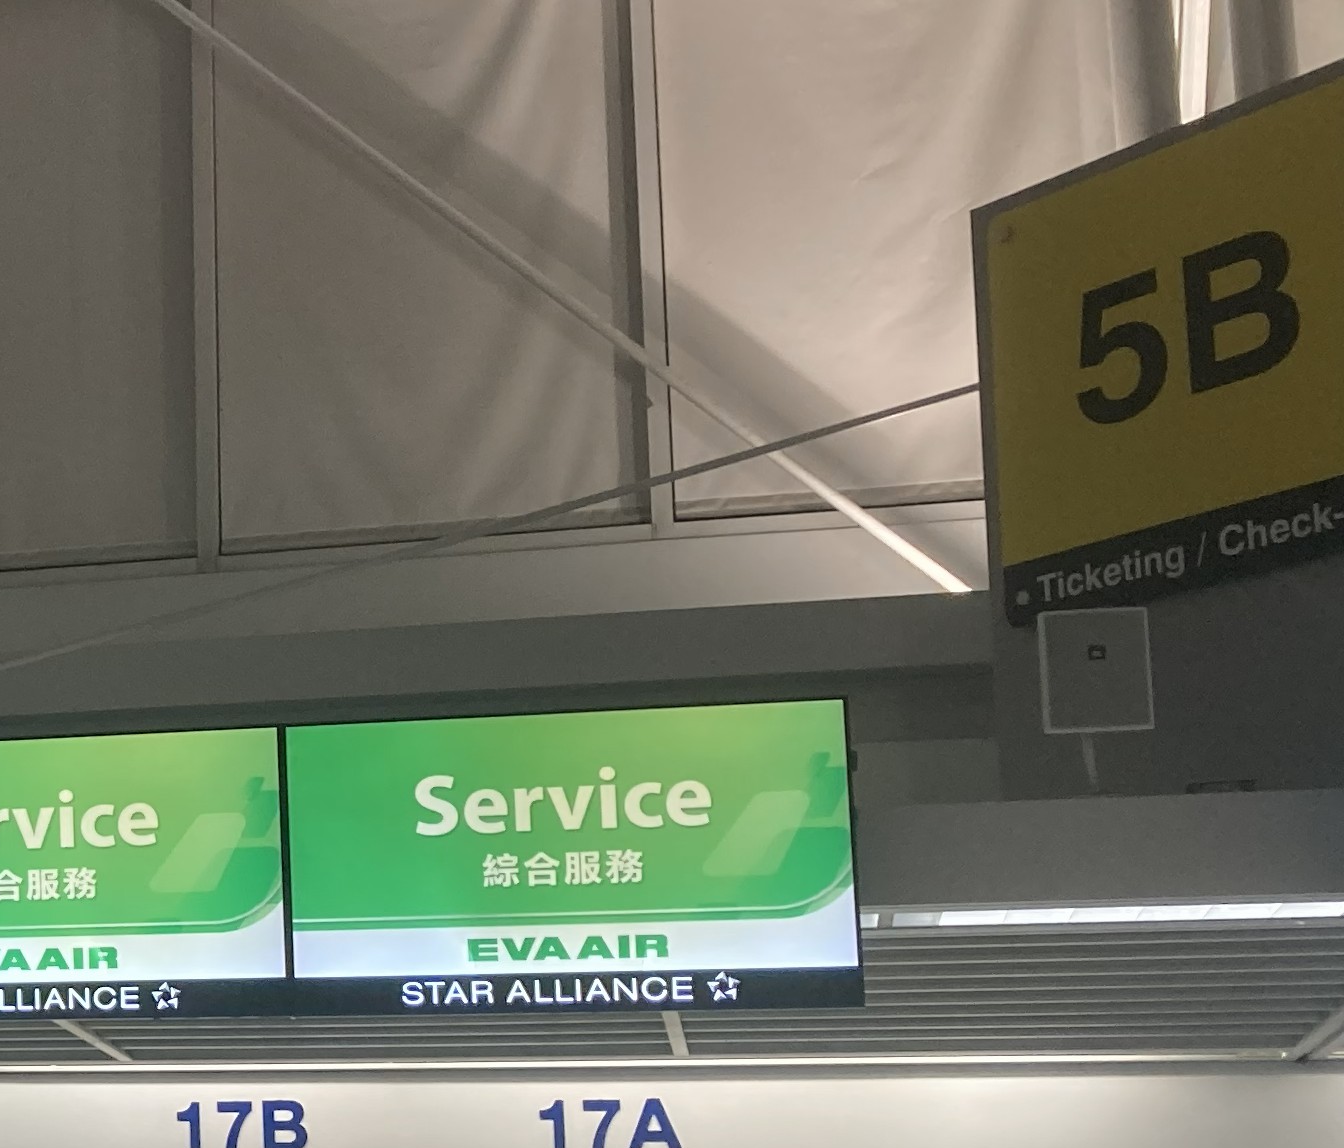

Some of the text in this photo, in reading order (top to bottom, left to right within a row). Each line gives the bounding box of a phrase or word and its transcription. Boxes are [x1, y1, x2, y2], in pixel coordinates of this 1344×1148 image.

[1076, 230, 1300, 425] 5B
[1037, 545, 1185, 602] Ticketing
[415, 765, 713, 837] Service
[482, 849, 644, 888] 綜合服務
[401, 976, 694, 1007] STAR ALLIANCE
